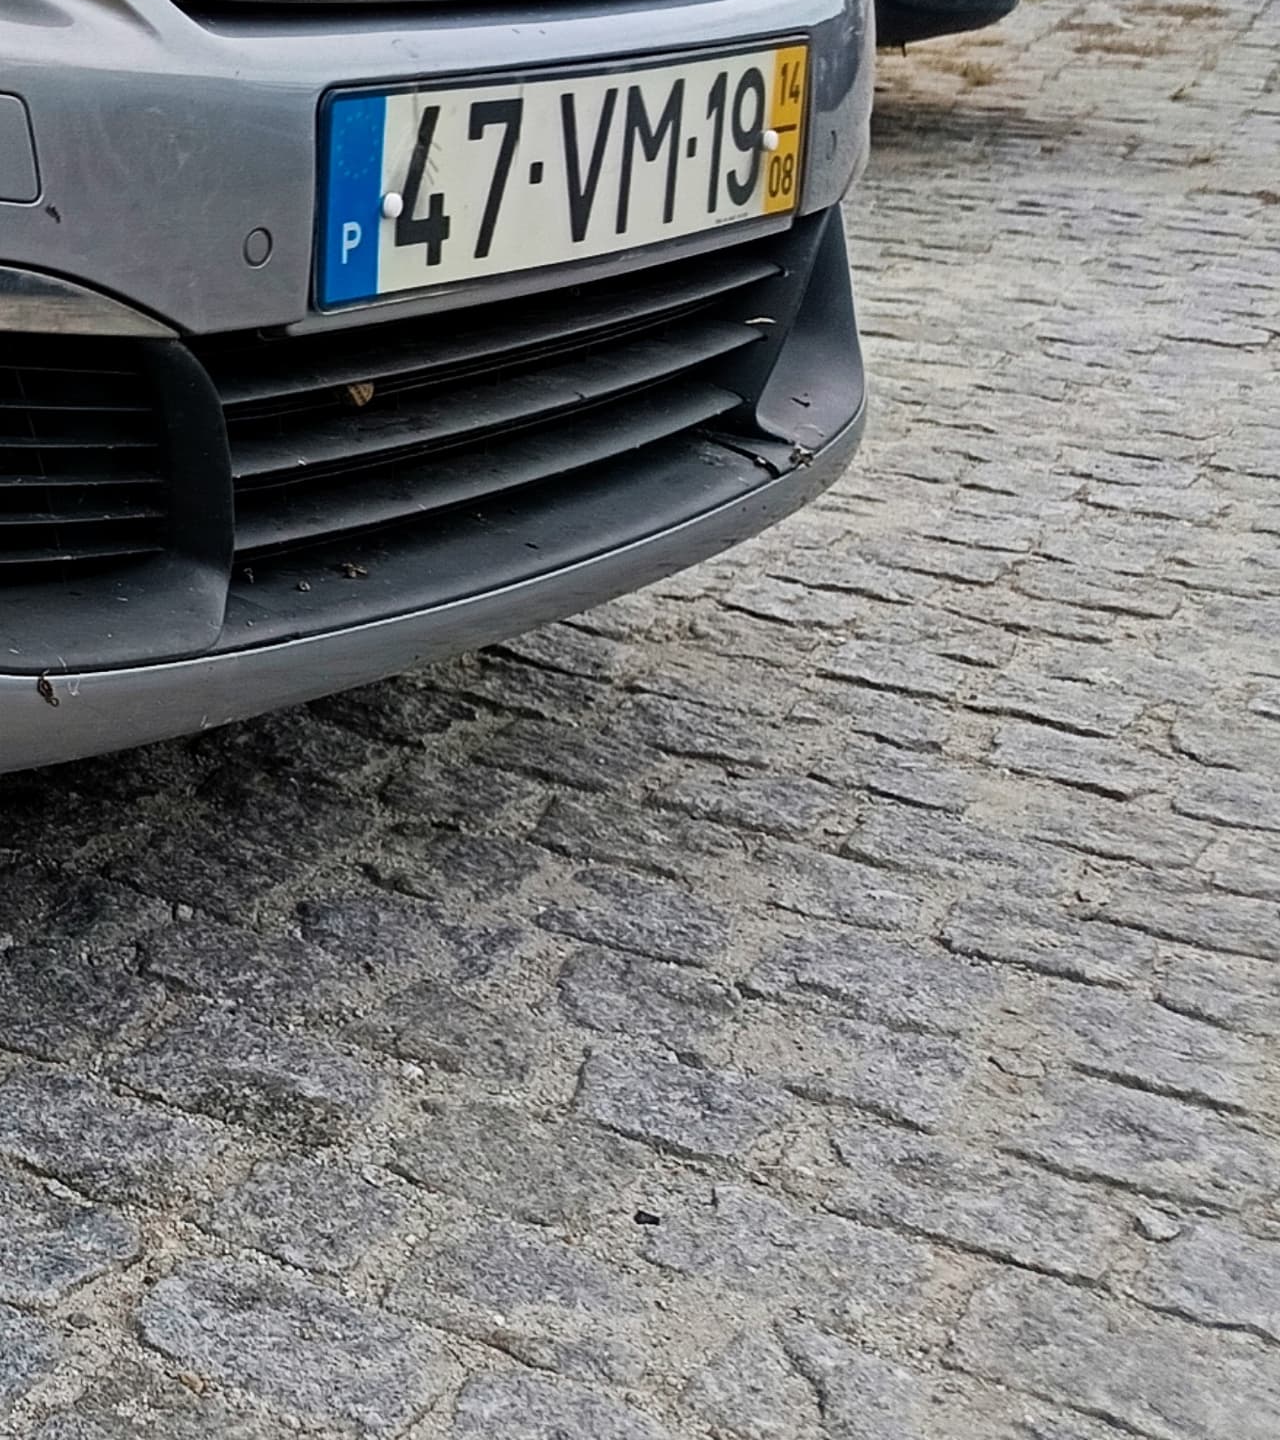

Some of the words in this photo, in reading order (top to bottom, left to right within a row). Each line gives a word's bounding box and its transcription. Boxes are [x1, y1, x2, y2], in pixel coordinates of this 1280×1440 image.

[780, 61, 800, 106] 14
[768, 153, 794, 198] 08
[342, 221, 362, 264] P
